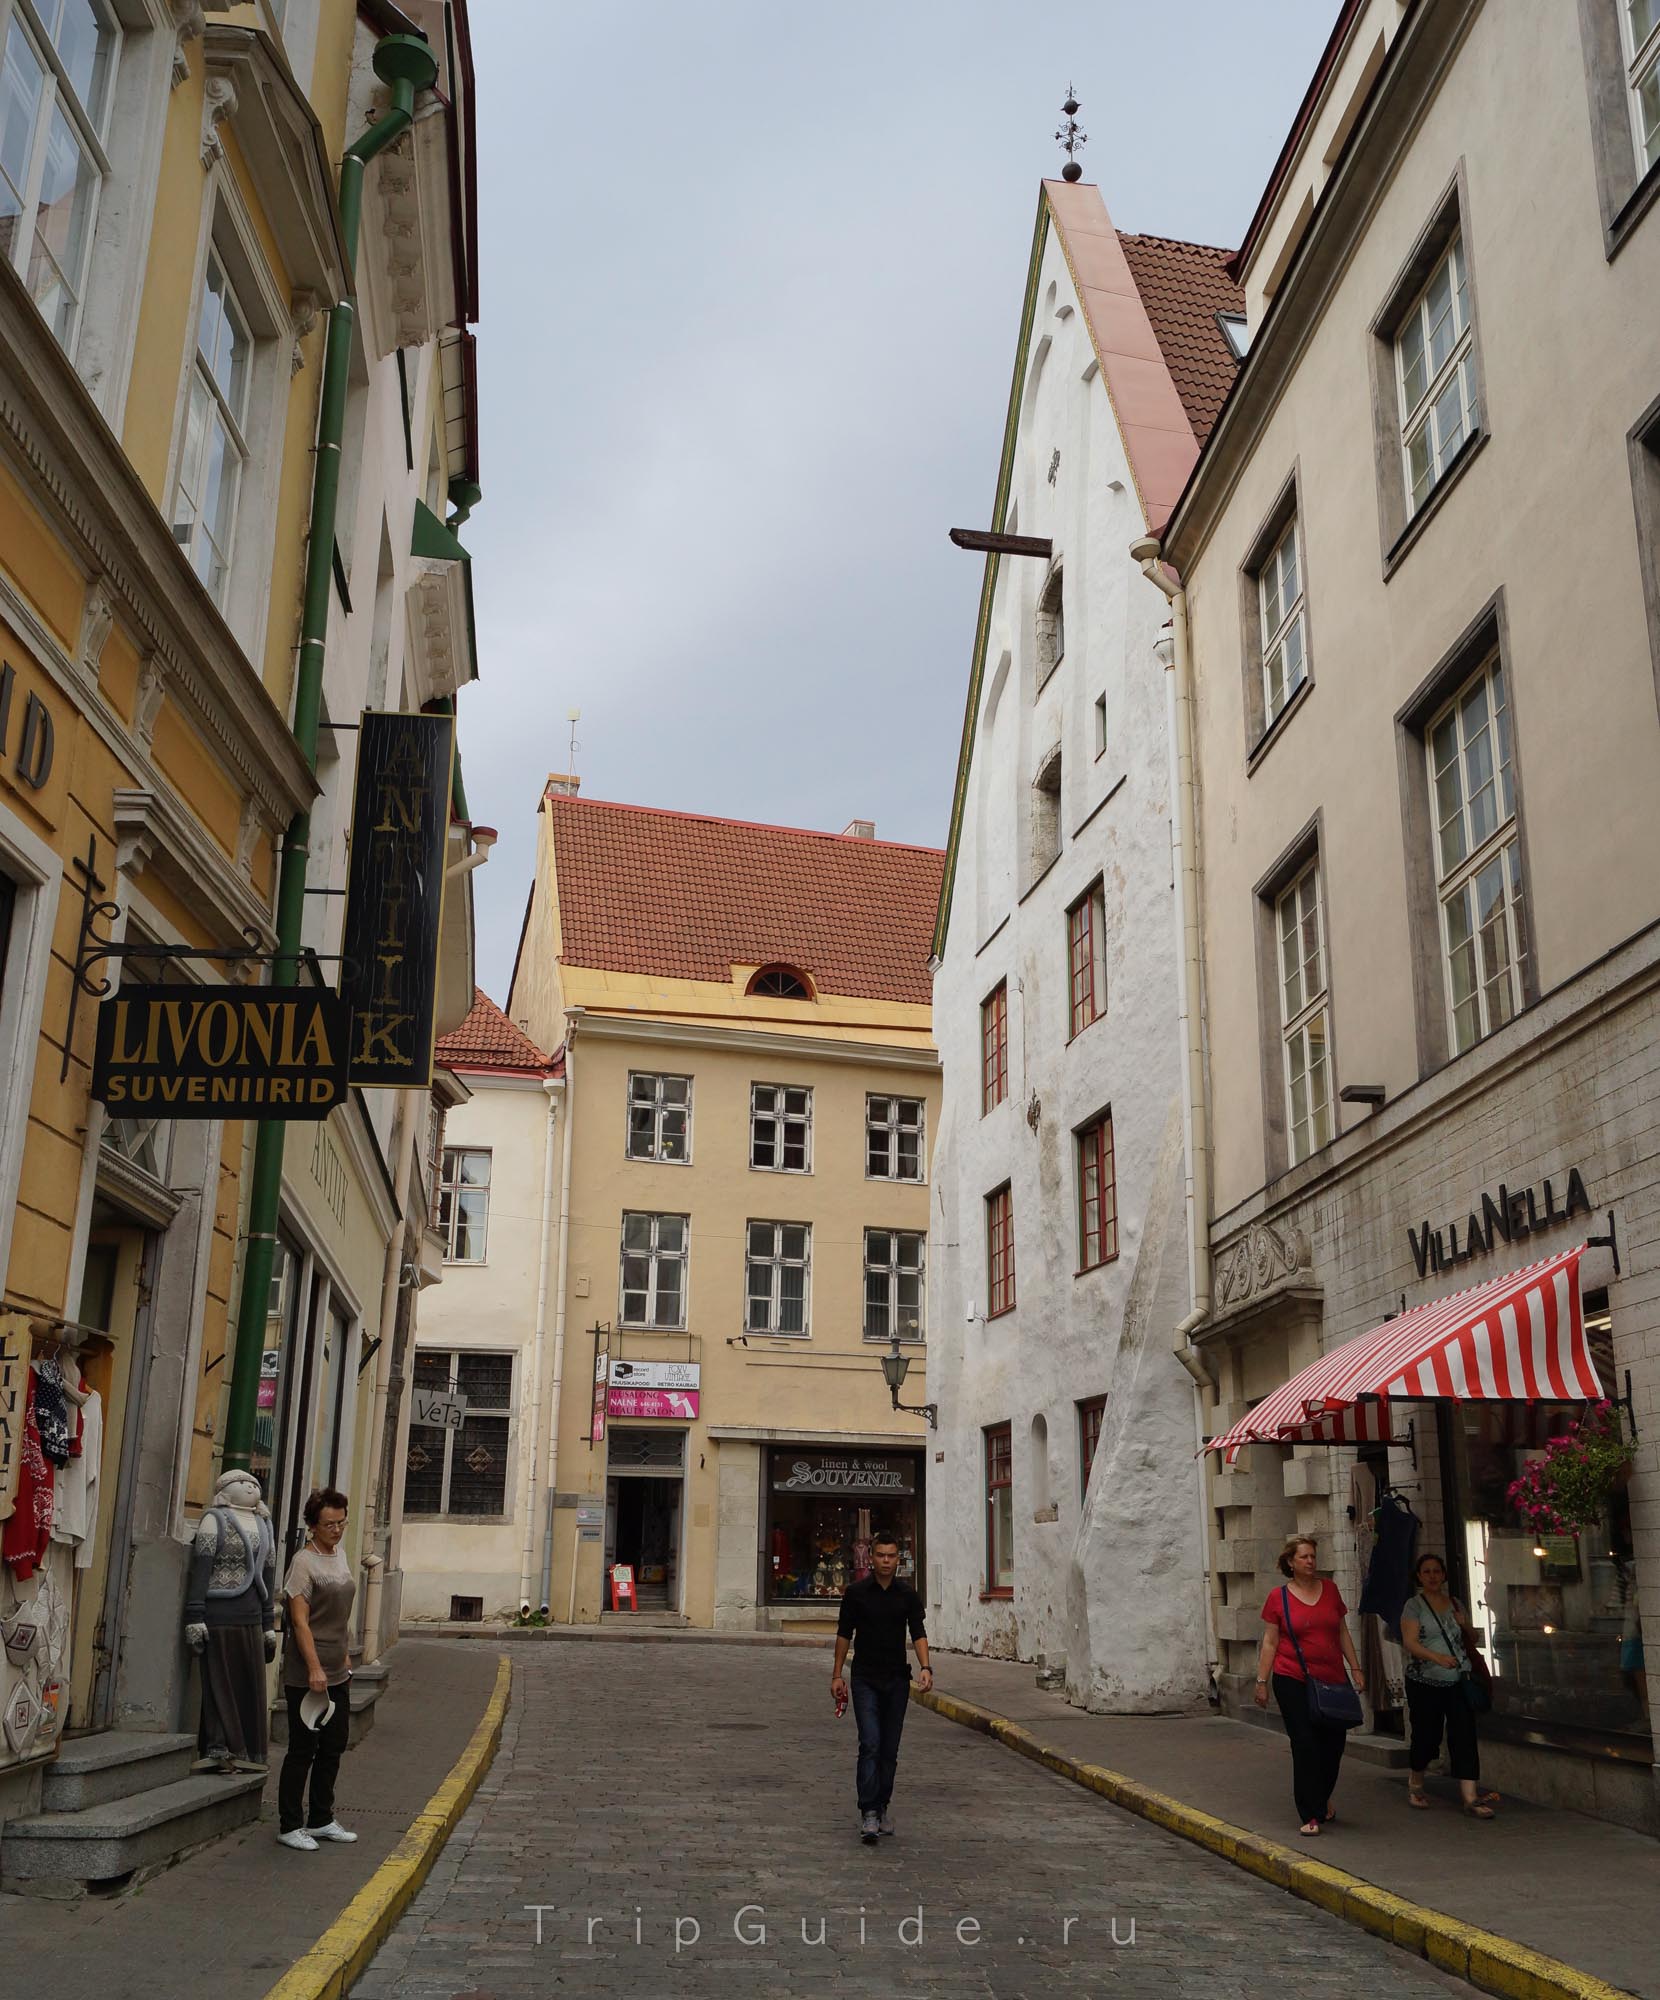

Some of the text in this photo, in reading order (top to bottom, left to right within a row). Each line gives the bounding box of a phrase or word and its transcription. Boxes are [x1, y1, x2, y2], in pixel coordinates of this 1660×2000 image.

[351, 733, 431, 1066] ANTIIK
[109, 1000, 335, 1067] LIVONIA
[107, 1075, 335, 1103] SUVENIIRID
[610, 1407, 676, 1416] BEAUTY SALON
[821, 1458, 888, 1470] linen & wool
